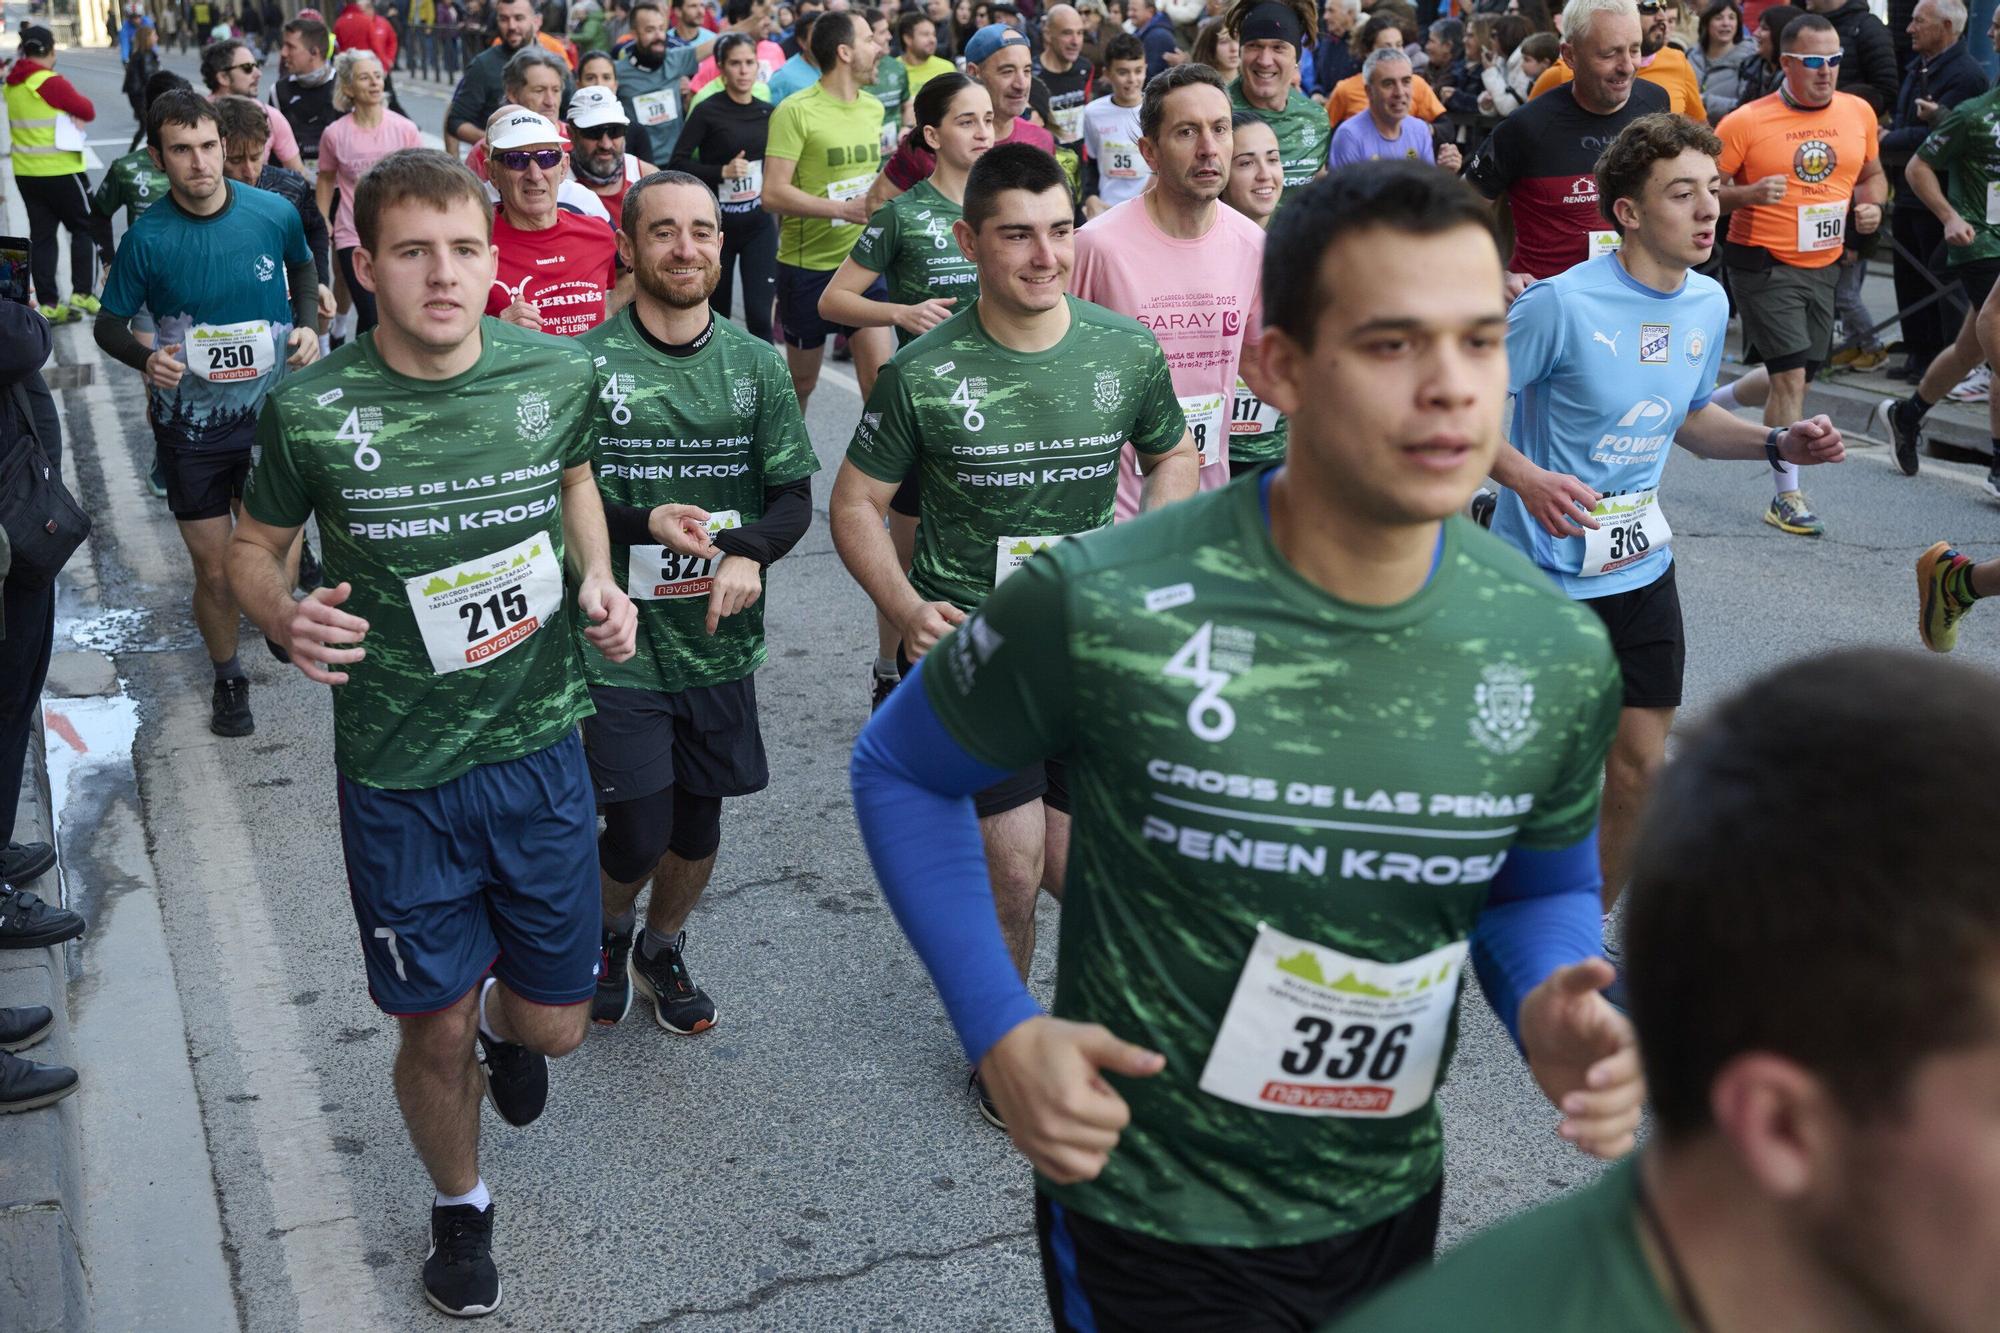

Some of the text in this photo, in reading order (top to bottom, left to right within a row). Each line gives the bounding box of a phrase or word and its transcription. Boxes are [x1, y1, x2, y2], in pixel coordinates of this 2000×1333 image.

[1786, 129, 1839, 142] PAMPLONA
[1801, 141, 1828, 152] BEER
[1114, 154, 1132, 169] 35
[732, 176, 754, 193] 317
[721, 198, 755, 213] NIKE
[1563, 194, 1600, 204] RENOVE
[925, 217, 948, 250] 46
[1816, 218, 1841, 239] 150
[926, 256, 963, 266] CROSS
[534, 280, 599, 297] CLUB ATLÉTICO
[928, 273, 977, 287] PEÑEN
[531, 290, 603, 309] LERINÉS
[1216, 296, 1237, 306] 2025
[543, 313, 598, 327] SAN SILVESTRE
[556, 322, 589, 335] DE LERÍN
[1136, 312, 1216, 330] SARAY
[208, 344, 255, 369] 250
[211, 369, 256, 380] navarban
[600, 371, 632, 425] 46
[949, 376, 985, 432] 46
[335, 406, 382, 472] 46
[598, 436, 653, 449] CROSS
[656, 439, 676, 448] DE
[680, 438, 712, 449] LAS
[951, 430, 1123, 456] CROSS DE LAS PEÑAS
[1596, 434, 1667, 453] POWER
[341, 458, 560, 500] CROSS DE LAS PEÑAS
[600, 462, 750, 480] PEÑEN KROSA
[956, 459, 1115, 488] PEÑEN KROSA
[349, 494, 557, 540] PEÑEN KROSA
[1610, 521, 1650, 559] 316
[432, 592, 448, 602] XLVI
[448, 588, 470, 598] CROSS
[505, 563, 531, 578] TAFALLA
[657, 580, 714, 595] navarban
[429, 596, 470, 611] TAFALLAKO
[459, 584, 529, 643] 215
[469, 618, 537, 661] navarban
[1162, 620, 1237, 742] 46
[1147, 758, 1534, 818] CROSS DE LAS PEÑAS
[1142, 814, 1327, 877] PEÑEN
[374, 927, 408, 981] 7
[1280, 1016, 1413, 1081] 336
[1267, 1083, 1391, 1111] navarban
